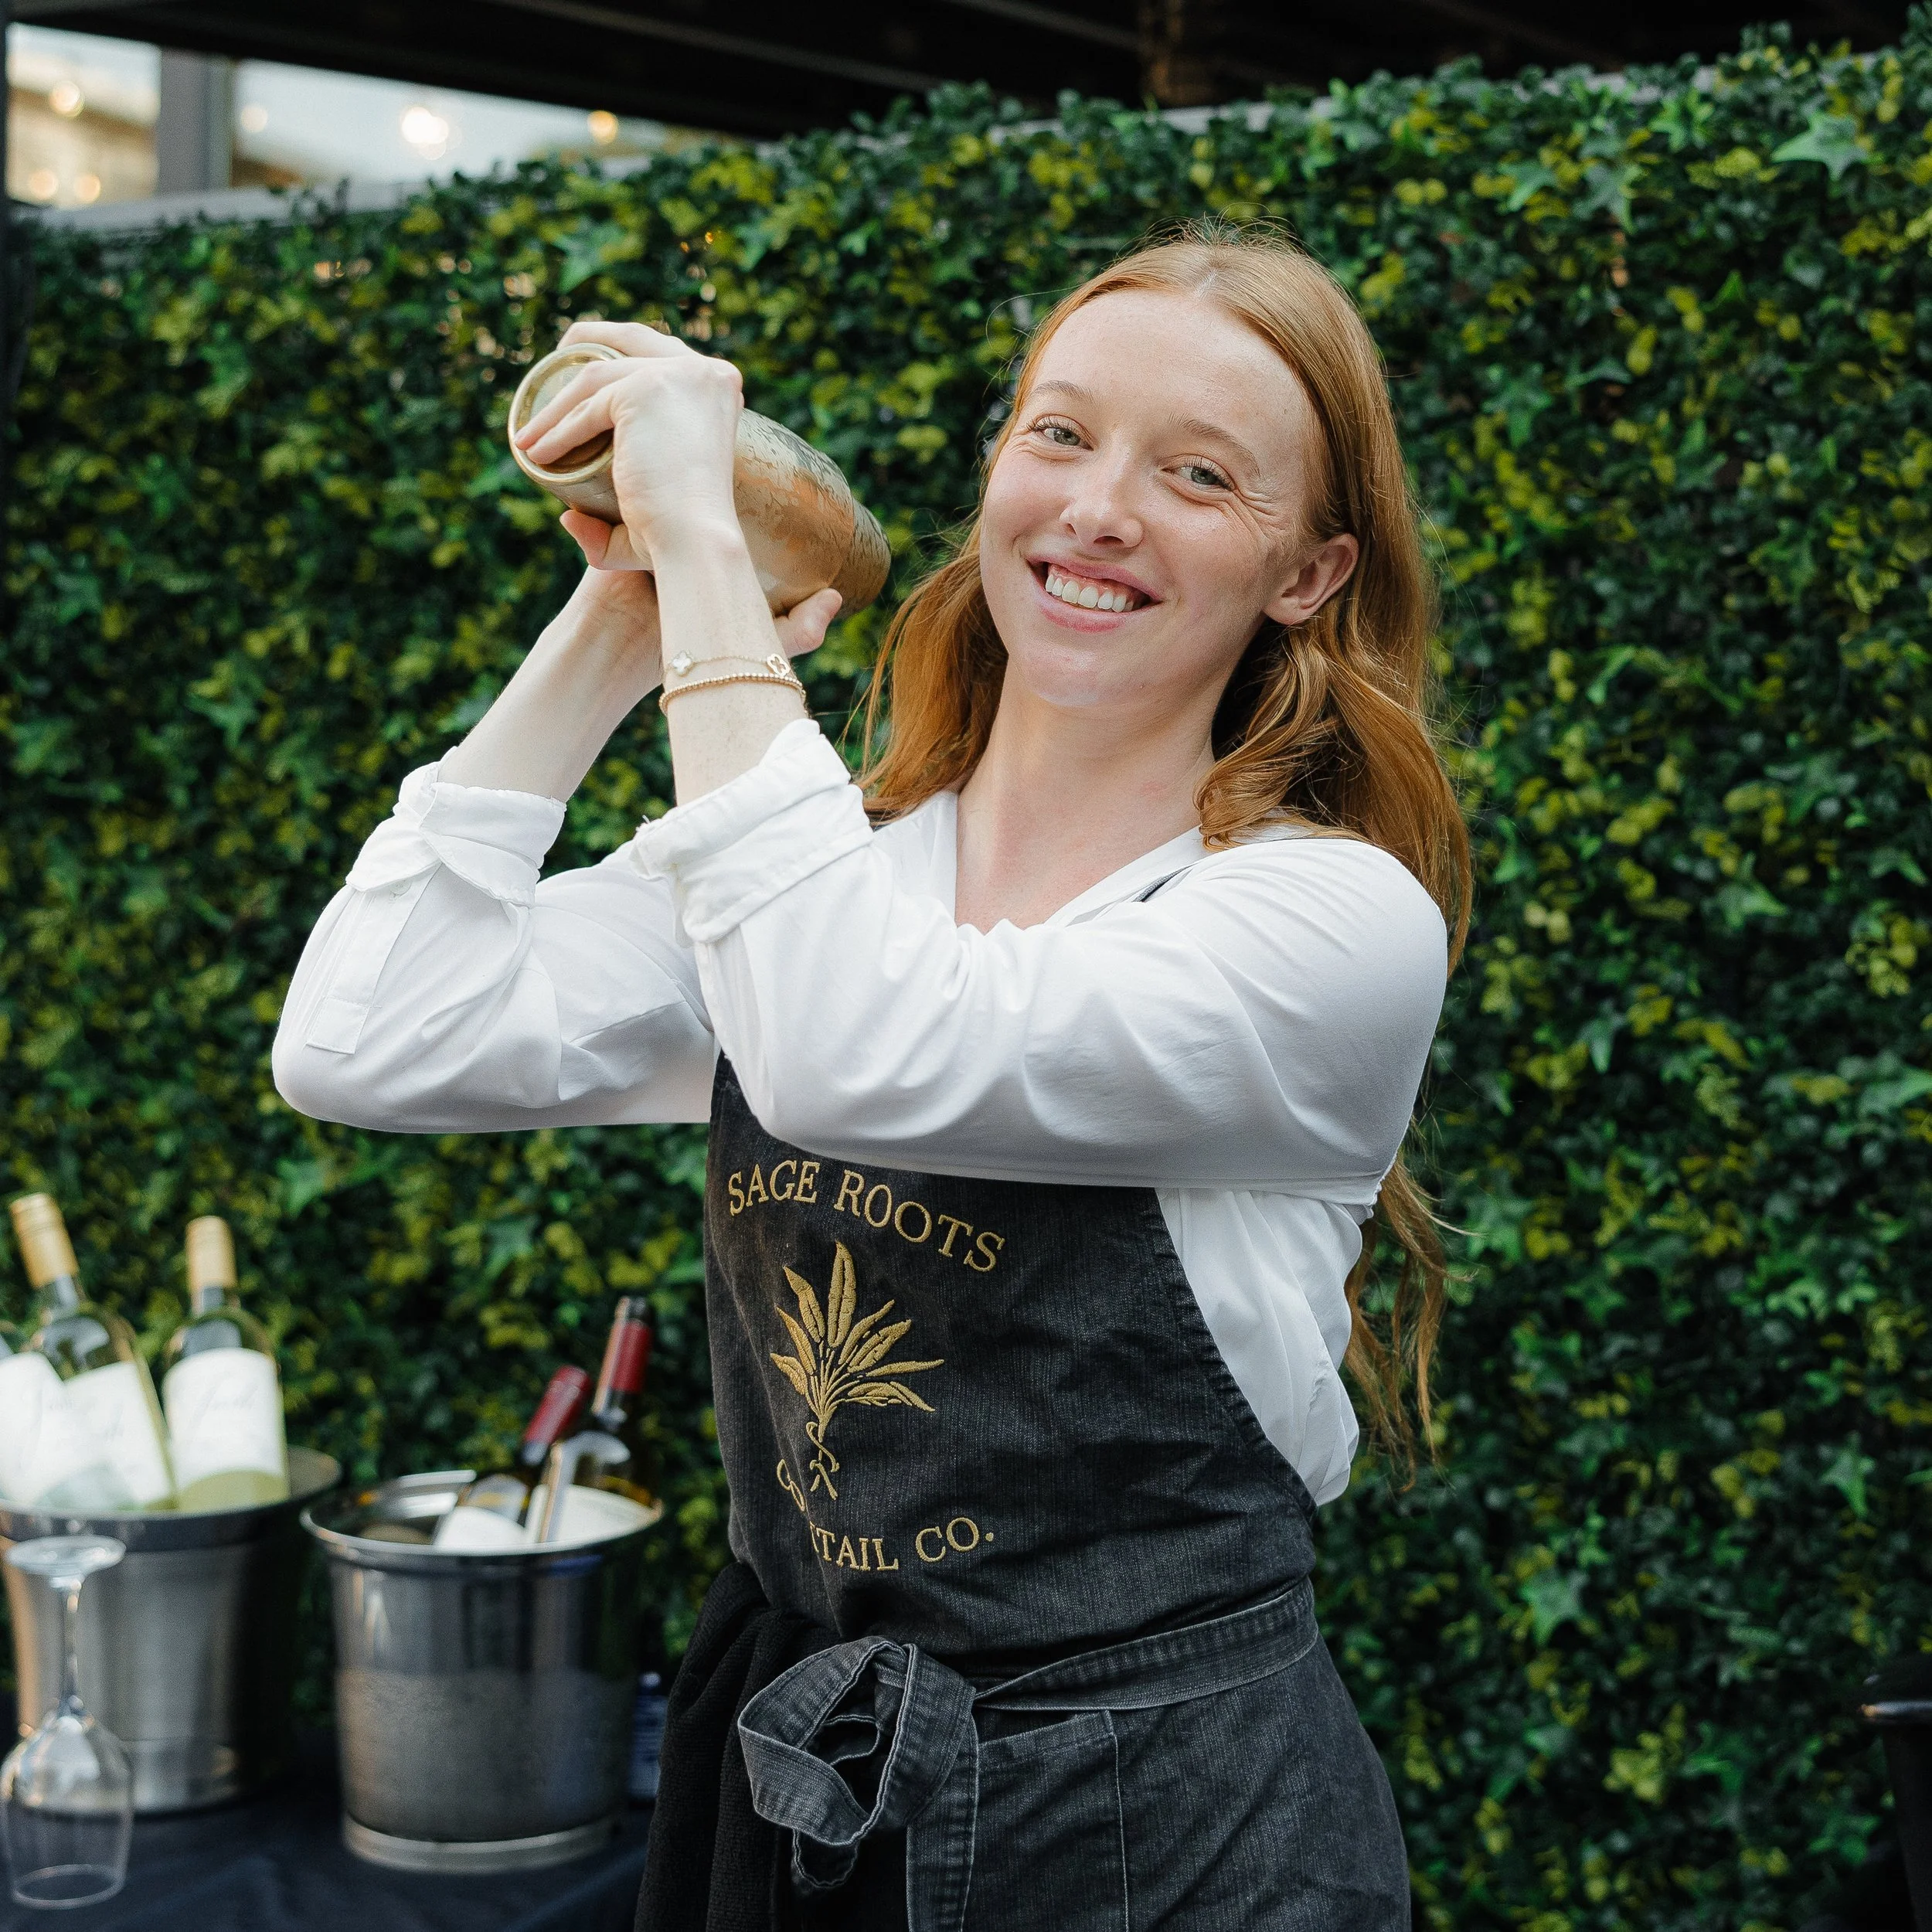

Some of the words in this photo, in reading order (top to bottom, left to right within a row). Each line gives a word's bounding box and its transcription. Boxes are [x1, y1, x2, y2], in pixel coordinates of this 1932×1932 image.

[728, 1160, 820, 1216] SAGE
[833, 1169, 1005, 1271] ROOTS
[777, 1458, 899, 1570] COTAIL
[916, 1517, 994, 1563] CO.
